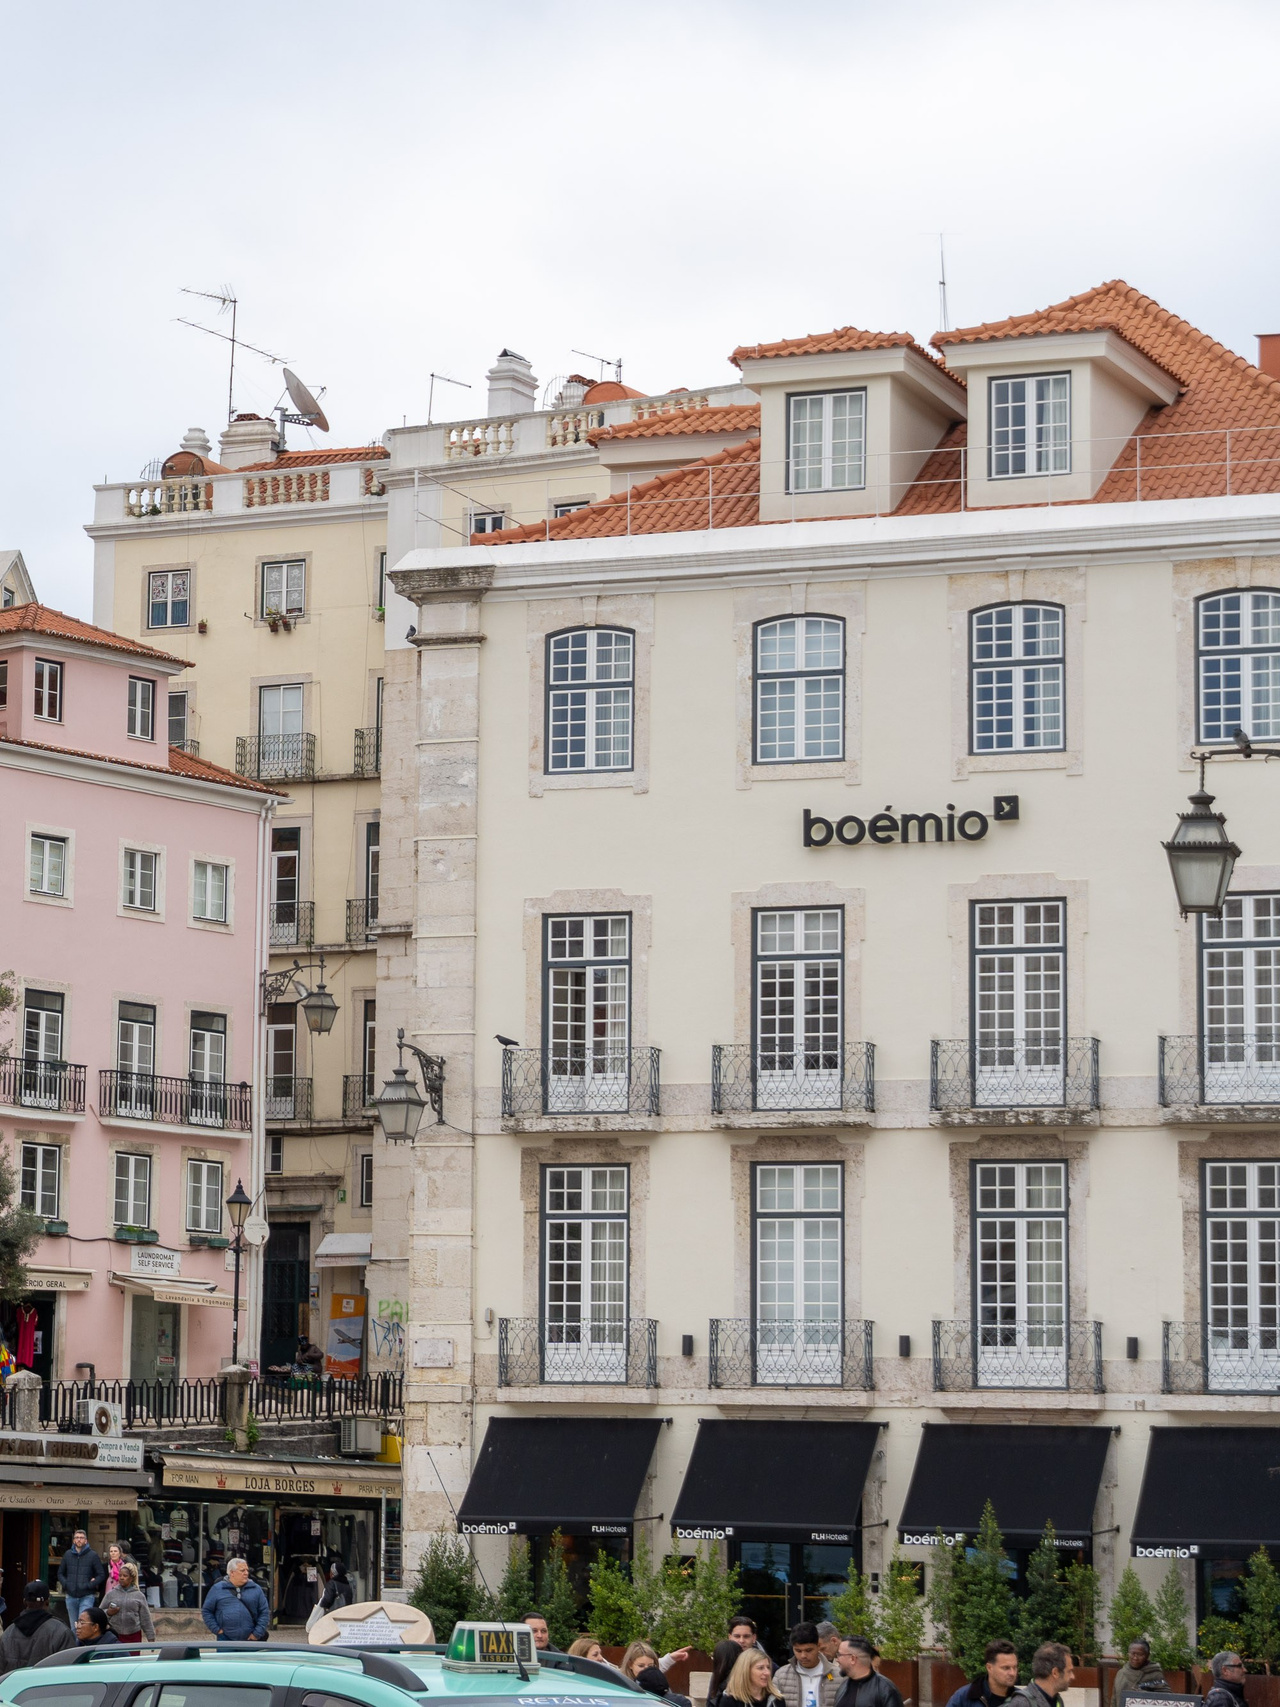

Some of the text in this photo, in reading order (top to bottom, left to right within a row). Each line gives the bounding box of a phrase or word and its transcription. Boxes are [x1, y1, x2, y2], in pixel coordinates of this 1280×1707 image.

[803, 803, 988, 847] boémio
[138, 1252, 174, 1260] LAUNDROMAT
[46, 1440, 99, 1460] RIBEIRO
[98, 1440, 118, 1451] Compra
[123, 1442, 140, 1452] Venda
[99, 1453, 137, 1463] de Ouro Usado
[172, 1473, 199, 1484] FOR MAN
[245, 1477, 314, 1492] LOJA BORGES
[358, 1485, 374, 1493] PARA
[8, 1495, 36, 1504] Usados
[462, 1522, 508, 1534] boémio
[676, 1526, 725, 1539] boémio
[1136, 1545, 1190, 1558] boémio
[480, 1631, 513, 1653] TAXI
[518, 1696, 609, 1706] RETÁLIS
